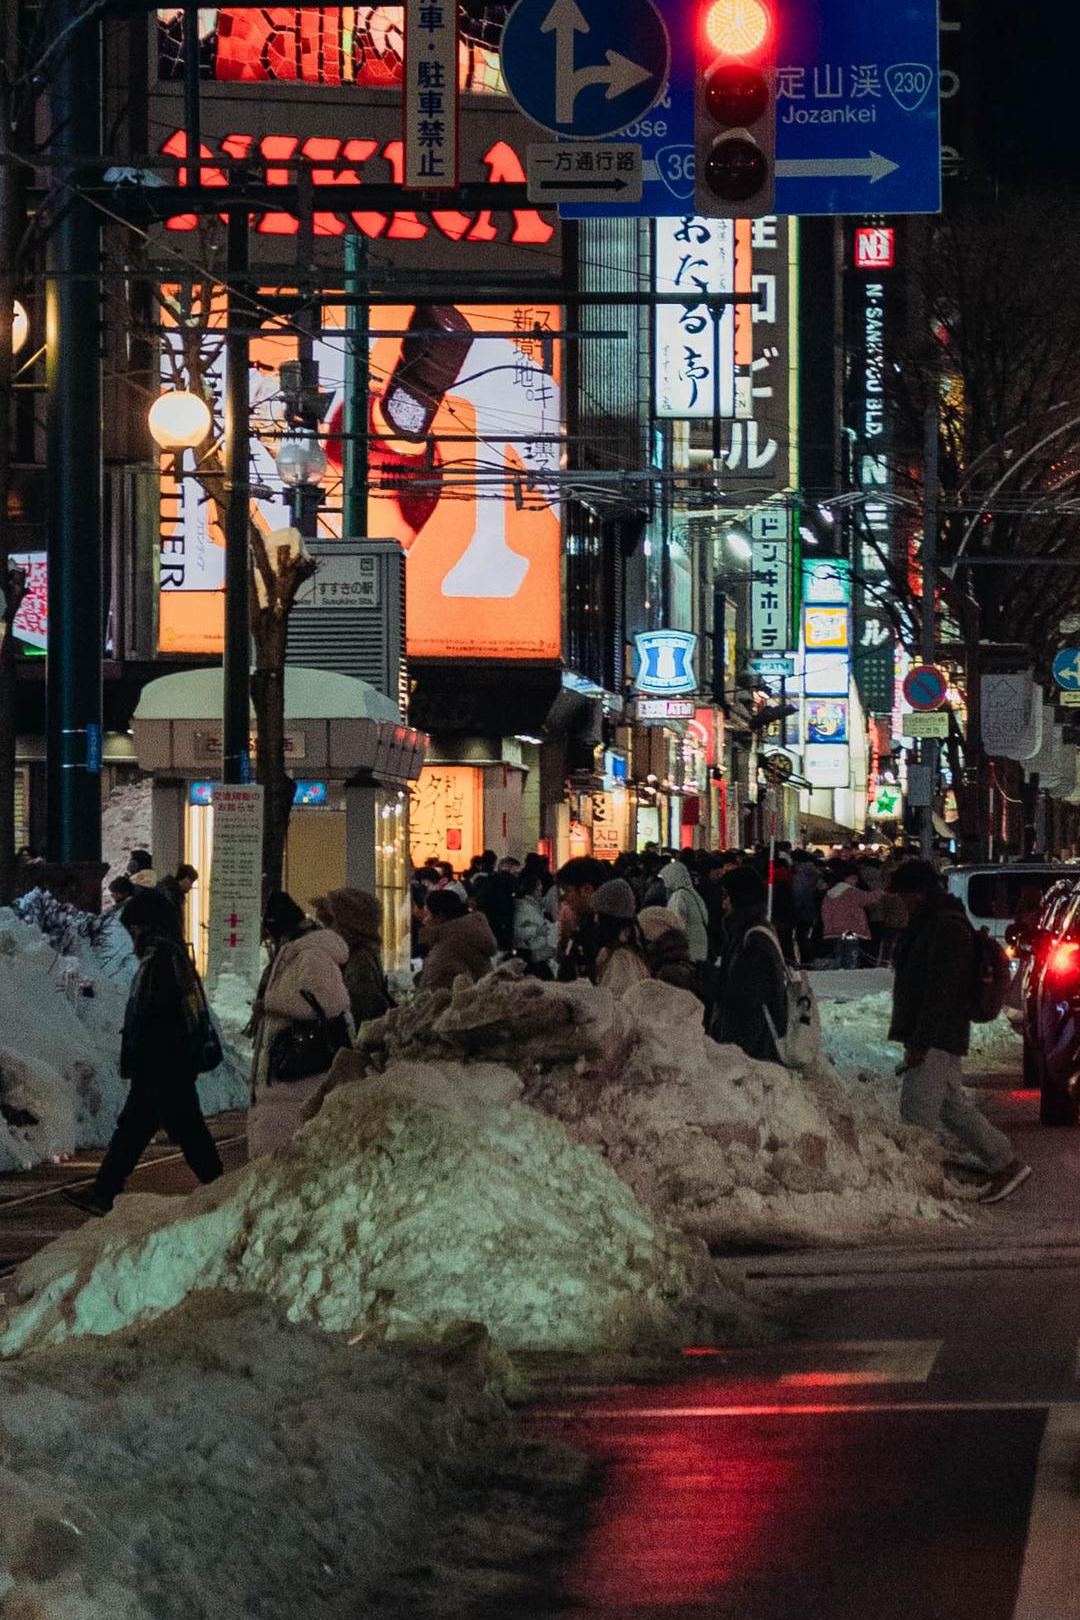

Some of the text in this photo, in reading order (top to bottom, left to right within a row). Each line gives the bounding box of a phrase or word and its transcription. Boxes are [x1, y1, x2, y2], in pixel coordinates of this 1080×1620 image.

[776, 64, 882, 100] 定山渓
[893, 72, 926, 93] 230
[782, 105, 877, 124] Jozankei
[535, 151, 635, 171] 一方通行路
